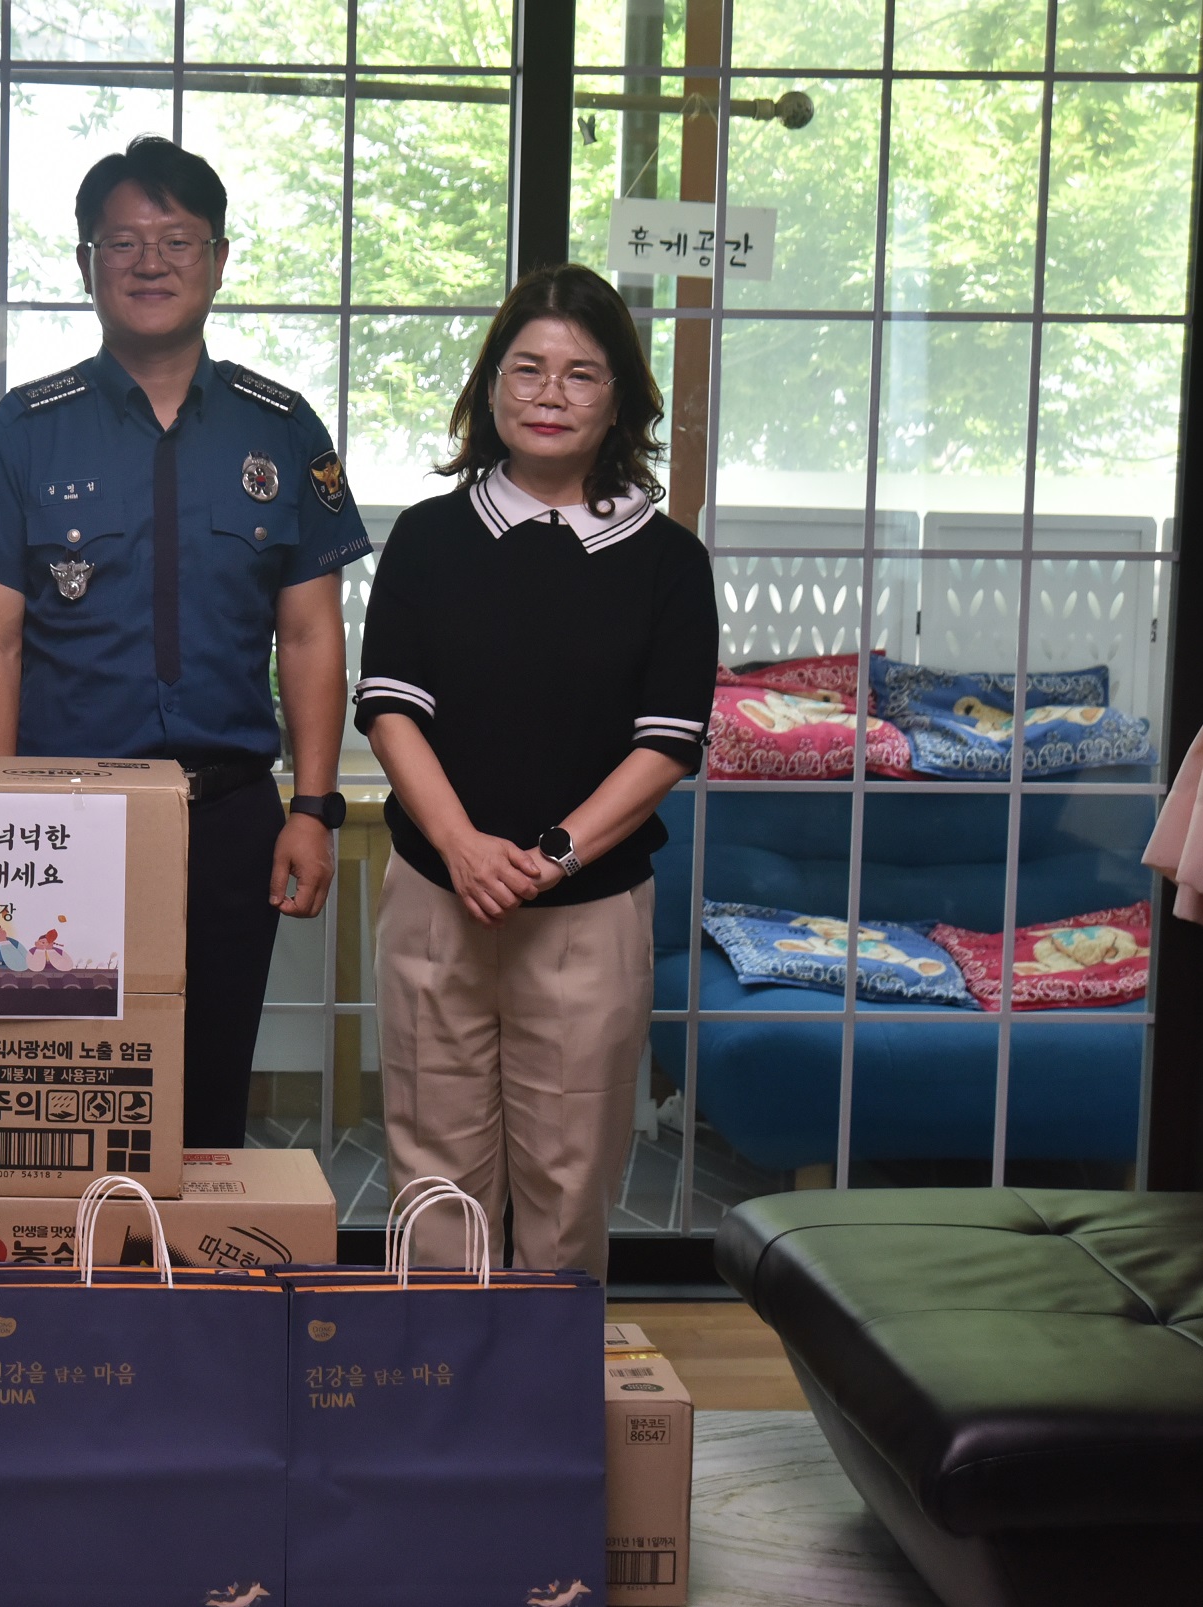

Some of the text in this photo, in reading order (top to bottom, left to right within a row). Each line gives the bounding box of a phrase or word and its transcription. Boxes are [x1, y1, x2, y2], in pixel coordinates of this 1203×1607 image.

[628, 225, 753, 267] 휴게공간
[326, 490, 343, 502] POLICE
[79, 1041, 113, 1061] 노출
[119, 1042, 153, 1062] 엄금
[1, 1067, 38, 1082] 개봉시
[43, 1068, 55, 1083] 칼
[60, 1068, 114, 1084] 사용금지"
[12, 1225, 84, 1239] 인생을 맛있
[54, 1366, 86, 1384] 담은
[94, 1362, 136, 1385] 마음
[305, 1362, 454, 1388] 건강을 담은 마음
[309, 1393, 356, 1409] TUNA
[630, 1417, 666, 1429] 발주코드
[630, 1430, 666, 1442] 86547
[605, 1537, 629, 1547] 031년
